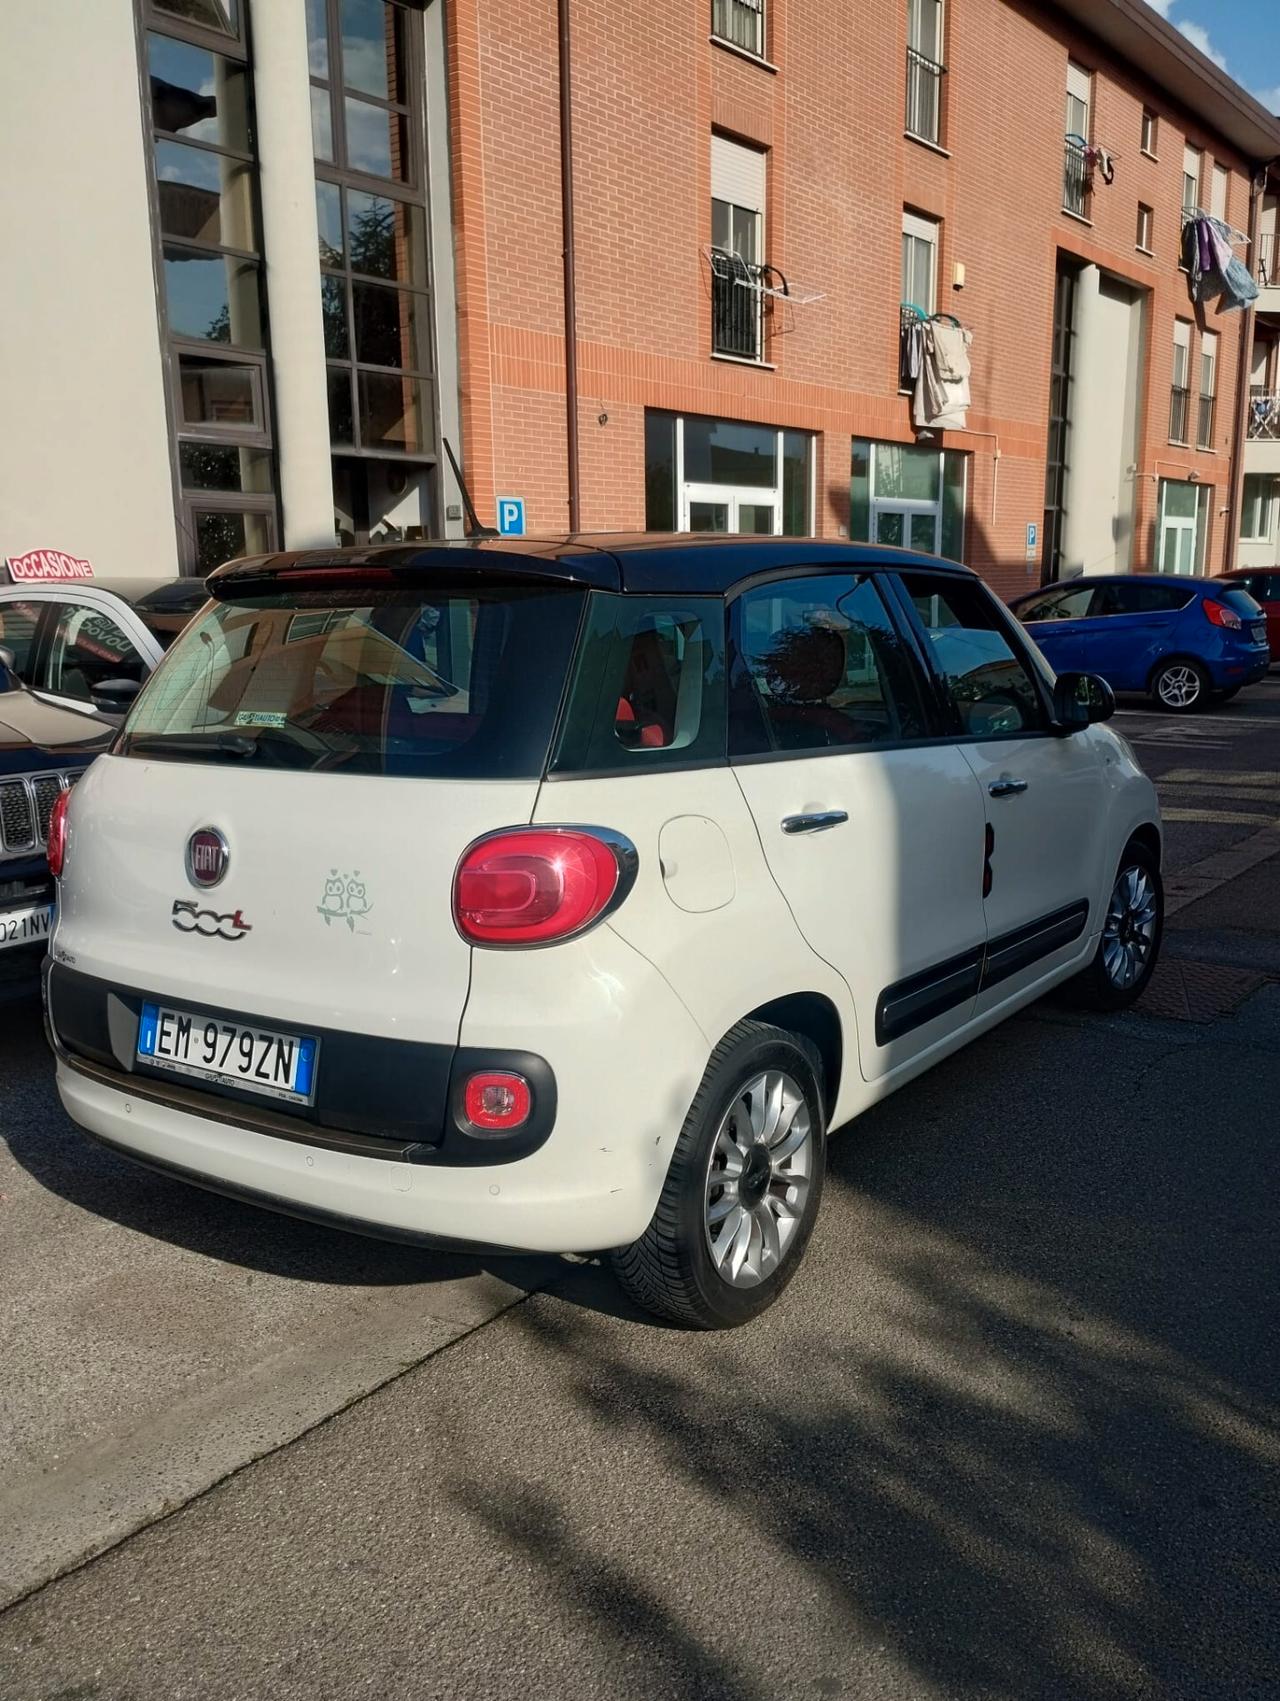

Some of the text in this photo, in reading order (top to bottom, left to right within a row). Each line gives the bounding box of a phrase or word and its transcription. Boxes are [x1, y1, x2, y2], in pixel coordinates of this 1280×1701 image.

[503, 503, 519, 531] P
[1029, 527, 1035, 544] P
[12, 551, 93, 578] OCCASIONE
[195, 844, 219, 872] FIAT
[172, 900, 253, 942] 500L
[158, 1012, 294, 1084] EM 979ZN
